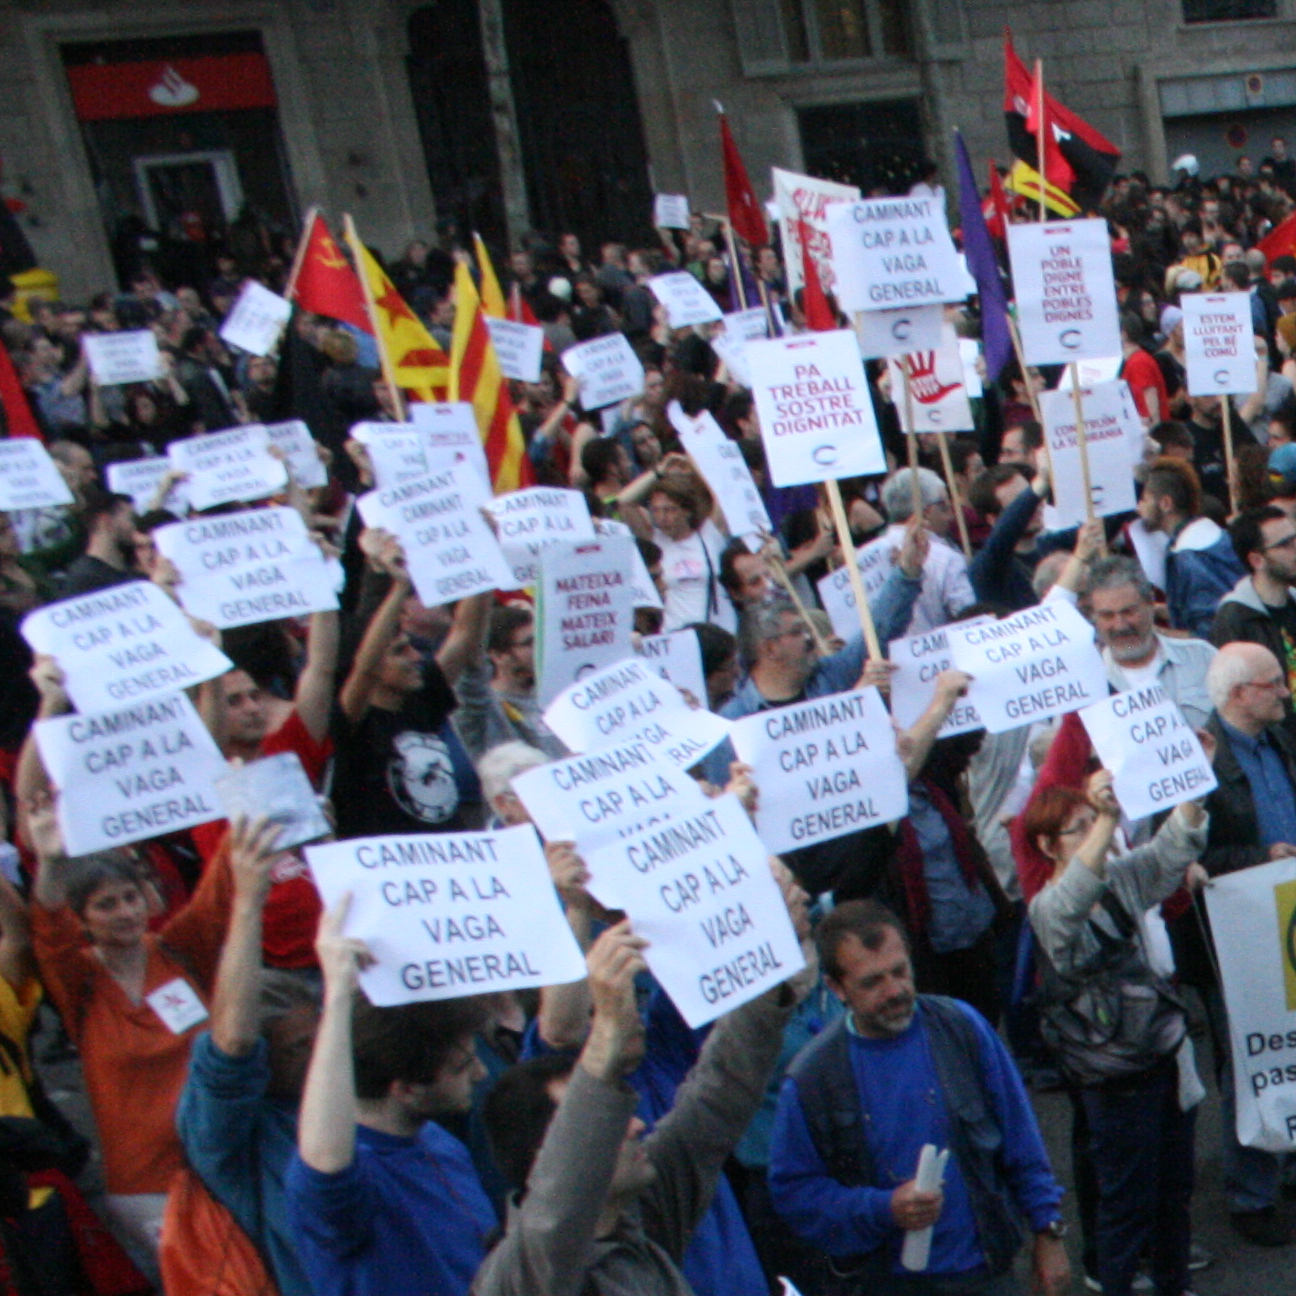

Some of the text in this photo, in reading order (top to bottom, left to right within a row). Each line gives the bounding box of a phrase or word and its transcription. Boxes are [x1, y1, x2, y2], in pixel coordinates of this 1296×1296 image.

[854, 201, 931, 223] CAMINANT
[863, 226, 934, 249] CAP A LA
[881, 254, 927, 273] VAGA
[870, 279, 944, 302] GENERAL
[794, 364, 821, 379] PA
[769, 377, 855, 401] TREBALL
[773, 411, 864, 436] DIGNITAT
[777, 396, 855, 420] SOSTRE
[557, 572, 622, 593] MATEIXA
[51, 588, 149, 628] CAMINANT
[568, 591, 610, 608] FEINA
[72, 615, 163, 651] CAP A LA
[562, 612, 617, 632] MATEIX
[964, 606, 1058, 646] CAMINANT
[109, 642, 167, 669] VAGA
[562, 630, 614, 650] SALARI
[985, 629, 1069, 664] CAP A LA
[106, 663, 196, 700] GENERAL
[1016, 657, 1068, 685] VAGA
[1005, 681, 1089, 719] GENERAL
[67, 697, 187, 744] CAMINANT
[766, 696, 864, 740] CAMINANT
[85, 730, 193, 774] CAP A LA
[779, 732, 868, 772] CAP A LA
[116, 767, 184, 798] VAGA
[807, 769, 860, 801] VAGA
[102, 797, 213, 838] GENERAL
[790, 799, 879, 840] GENERAL
[356, 839, 499, 869] CAMINANT
[628, 810, 725, 873] CAMINANT
[381, 876, 509, 907] CAP A LA
[660, 855, 749, 913] CAP A LA
[423, 916, 504, 943] VAGA
[702, 905, 754, 949] VAGA
[402, 953, 540, 990] GENERAL
[700, 943, 782, 1004] GENERAL
